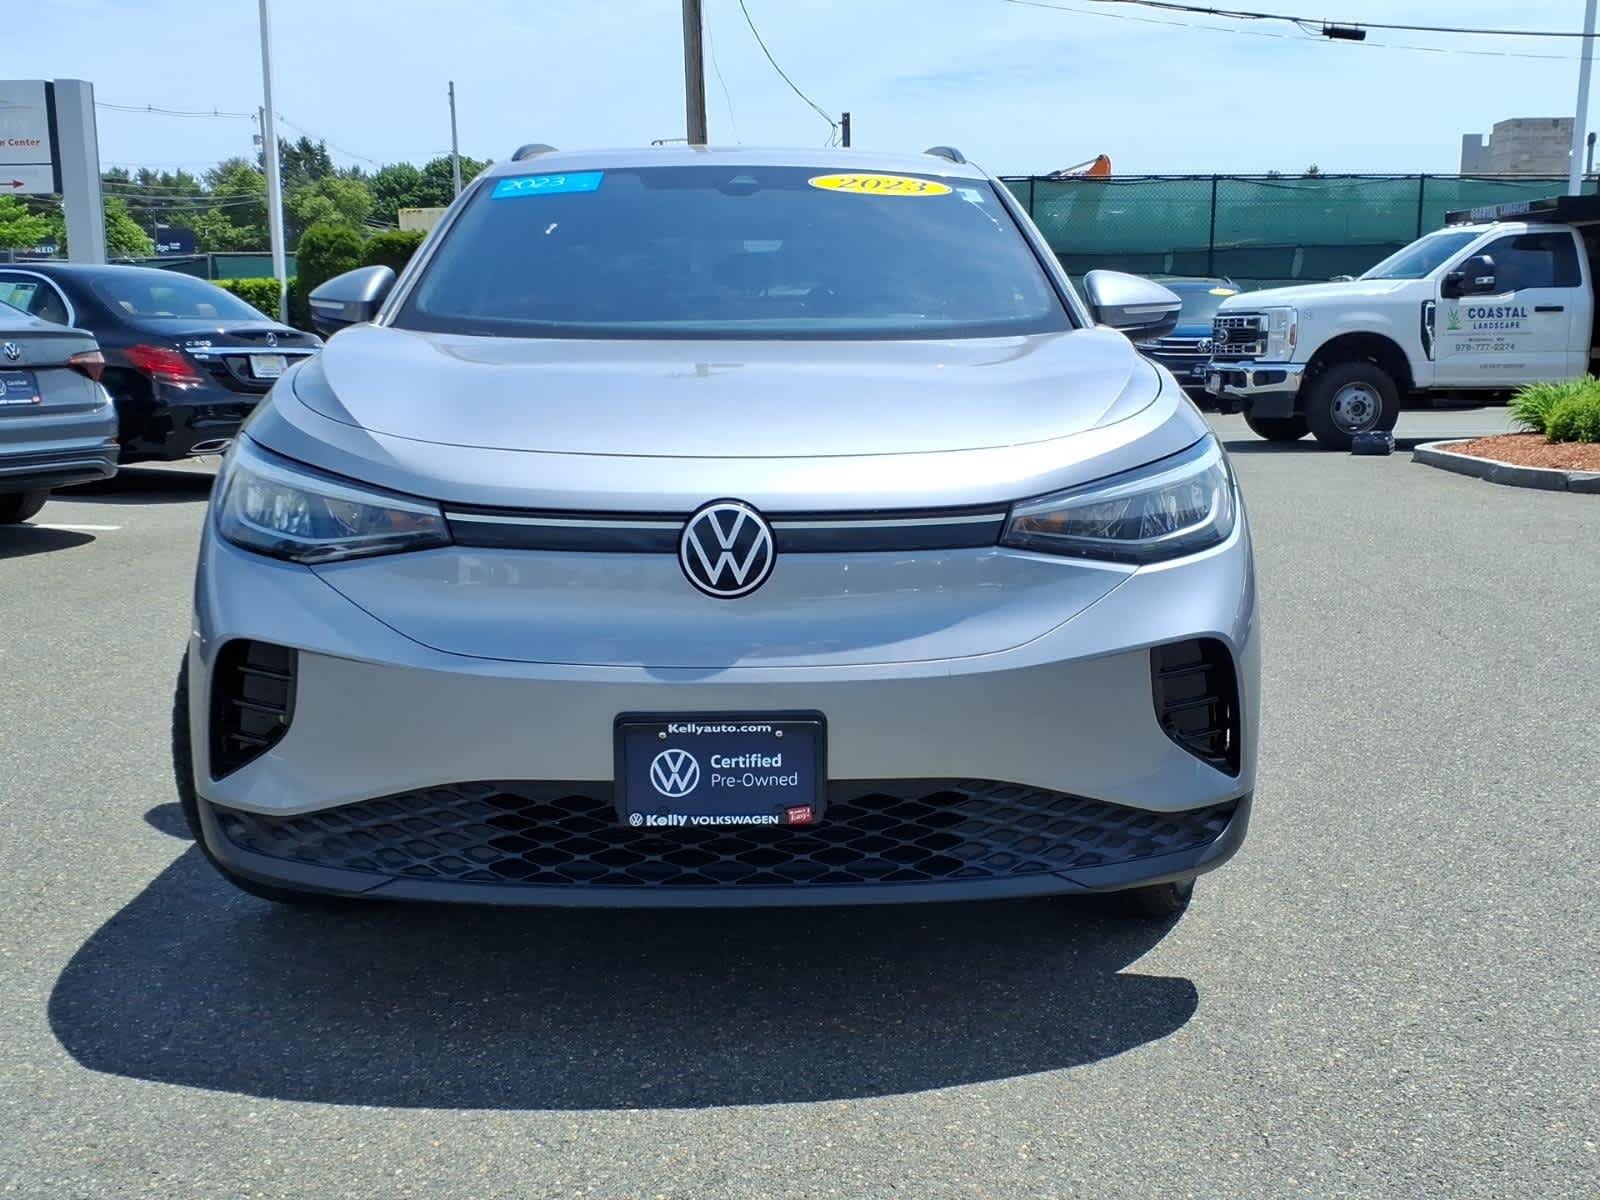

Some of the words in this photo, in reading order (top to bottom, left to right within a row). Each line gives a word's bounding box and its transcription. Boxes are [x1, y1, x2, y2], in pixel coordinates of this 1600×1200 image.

[8, 138, 40, 146] Center
[502, 176, 566, 191] 2023
[839, 178, 927, 191] 2023
[1468, 306, 1527, 319] COASTAL
[1473, 321, 1520, 330] LANDSCAPE
[668, 723, 772, 735] Kellyauto.com
[710, 753, 782, 768] Certified
[711, 772, 798, 787] Pre-Owned
[646, 814, 687, 827] Kelly
[691, 815, 779, 825] VOLKSWAGEN
